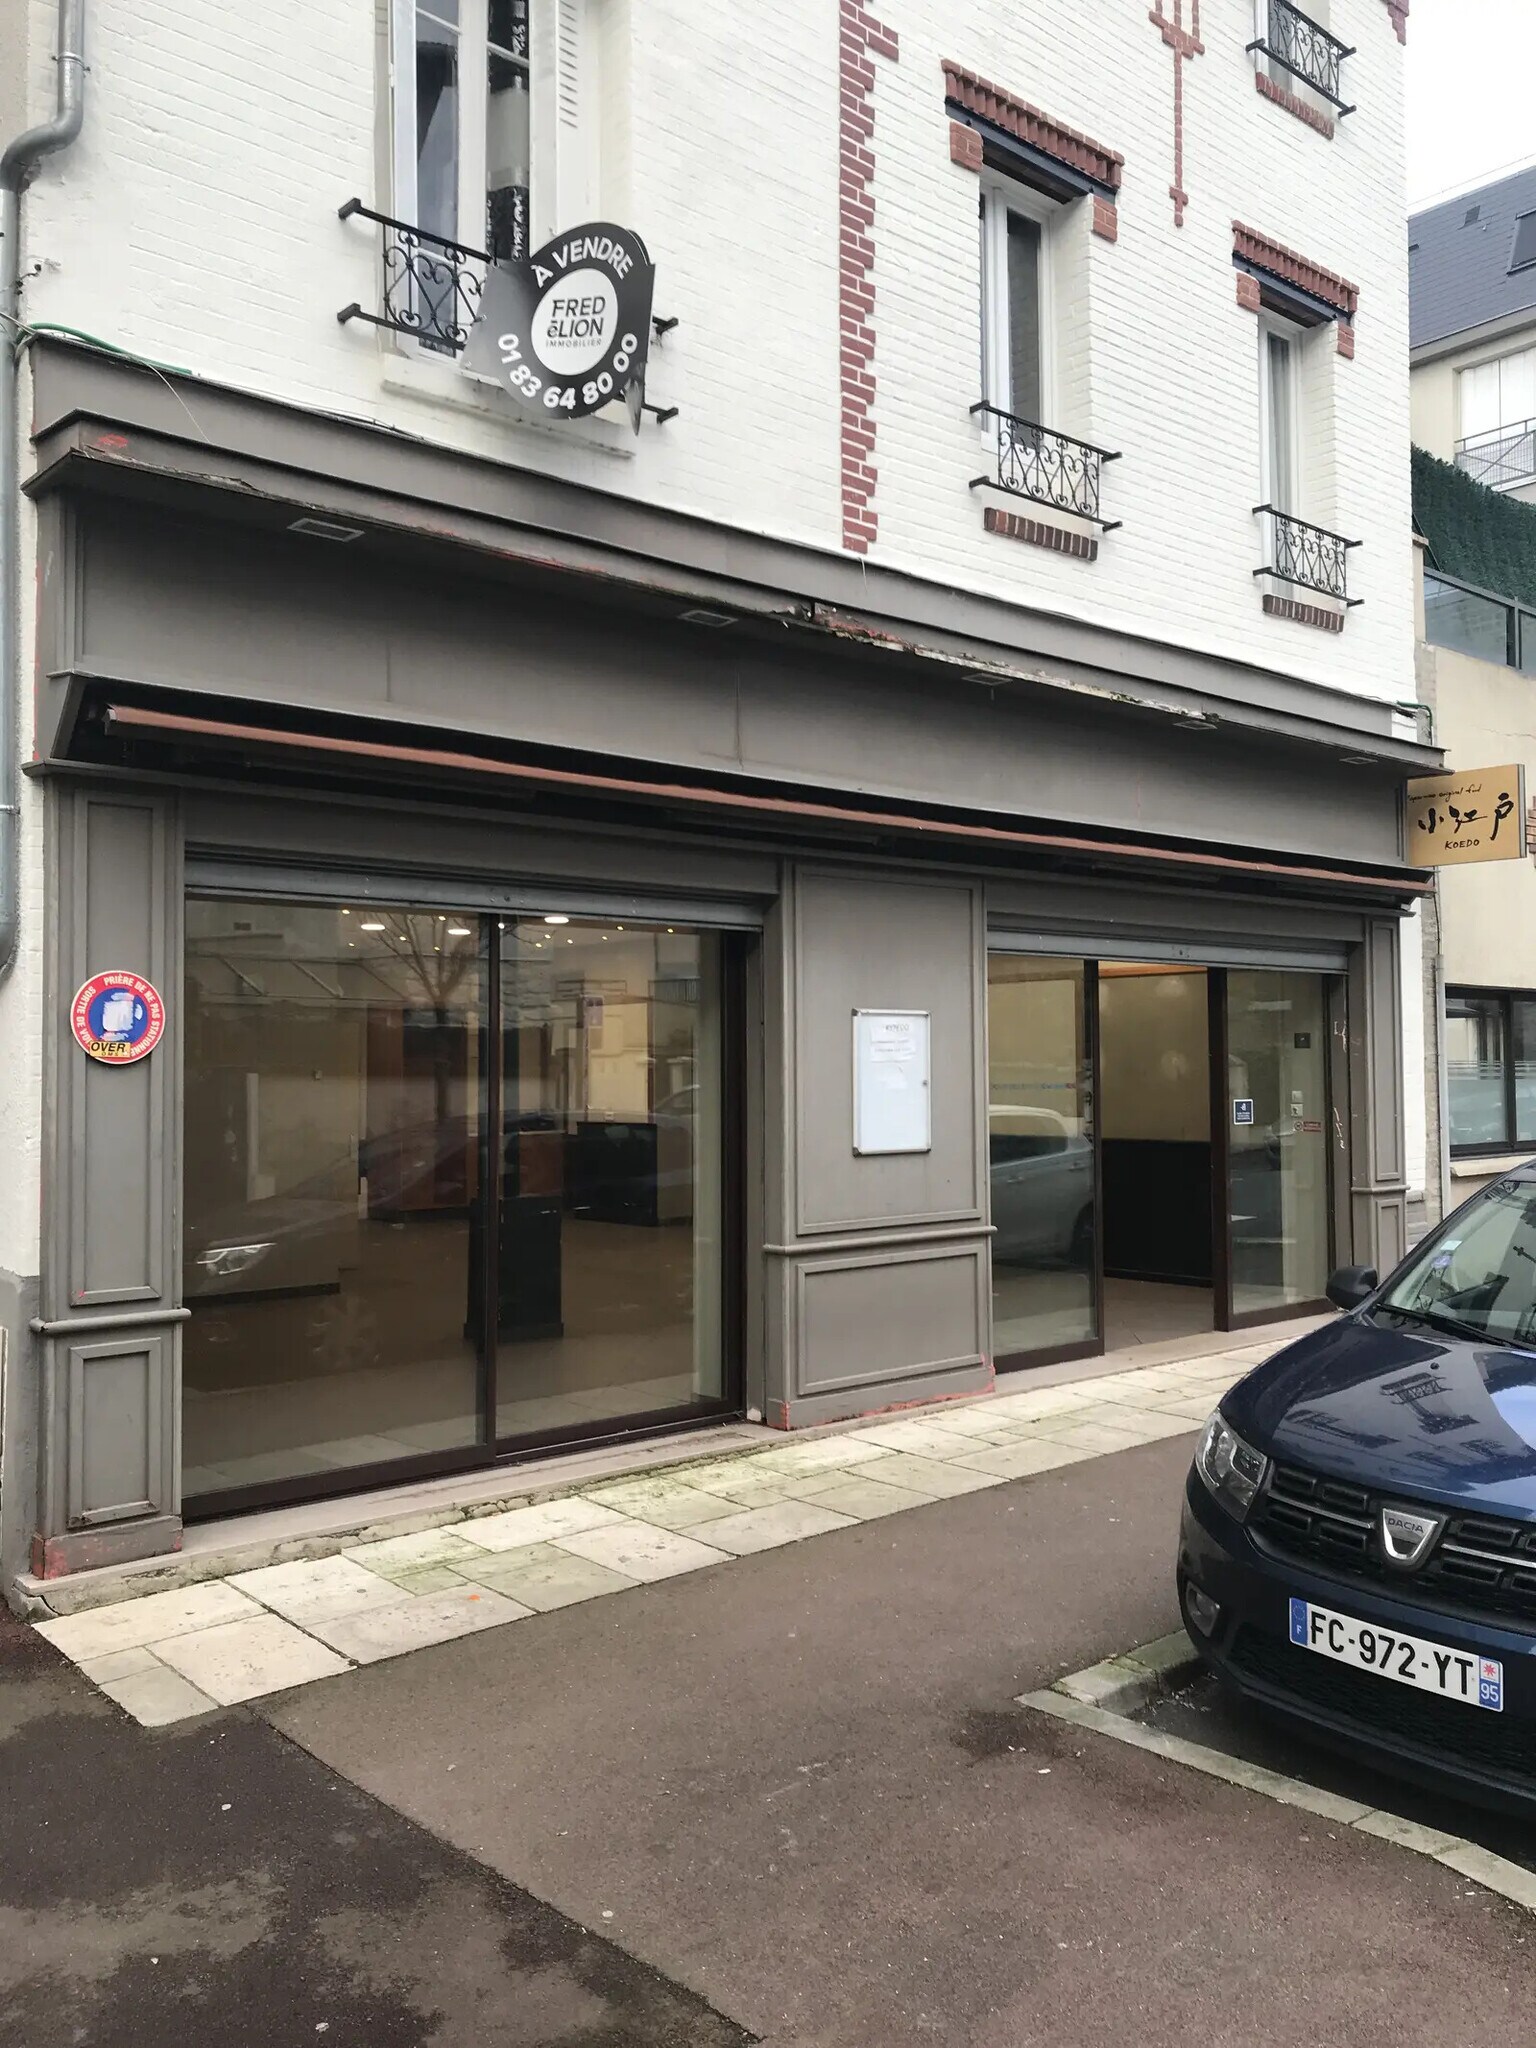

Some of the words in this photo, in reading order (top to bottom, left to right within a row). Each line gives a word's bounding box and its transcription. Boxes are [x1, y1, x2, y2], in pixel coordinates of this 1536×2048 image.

[552, 236, 633, 280] VENDRE
[552, 296, 606, 317] FRED
[497, 333, 522, 365] 01
[546, 338, 602, 348] IMMOBILIER
[613, 333, 638, 373] 00
[509, 364, 542, 398] 83
[582, 371, 614, 405] 80
[543, 386, 576, 410] 64
[1438, 787, 1464, 803] original
[1444, 839, 1480, 850] KOEDO
[104, 973, 134, 987] PRIÈRE
[134, 981, 147, 993] DE
[78, 986, 96, 1014] SORTIE
[144, 991, 155, 1003] NE
[150, 1003, 160, 1018] PAS
[76, 1017, 86, 1029] DE
[91, 1042, 126, 1053] OVER
[131, 1021, 160, 1057] STATIONNE
[1387, 1517, 1425, 1534] DACIA
[1310, 1610, 1474, 1696] FC-972-YT
[1480, 1682, 1499, 1703] 95
